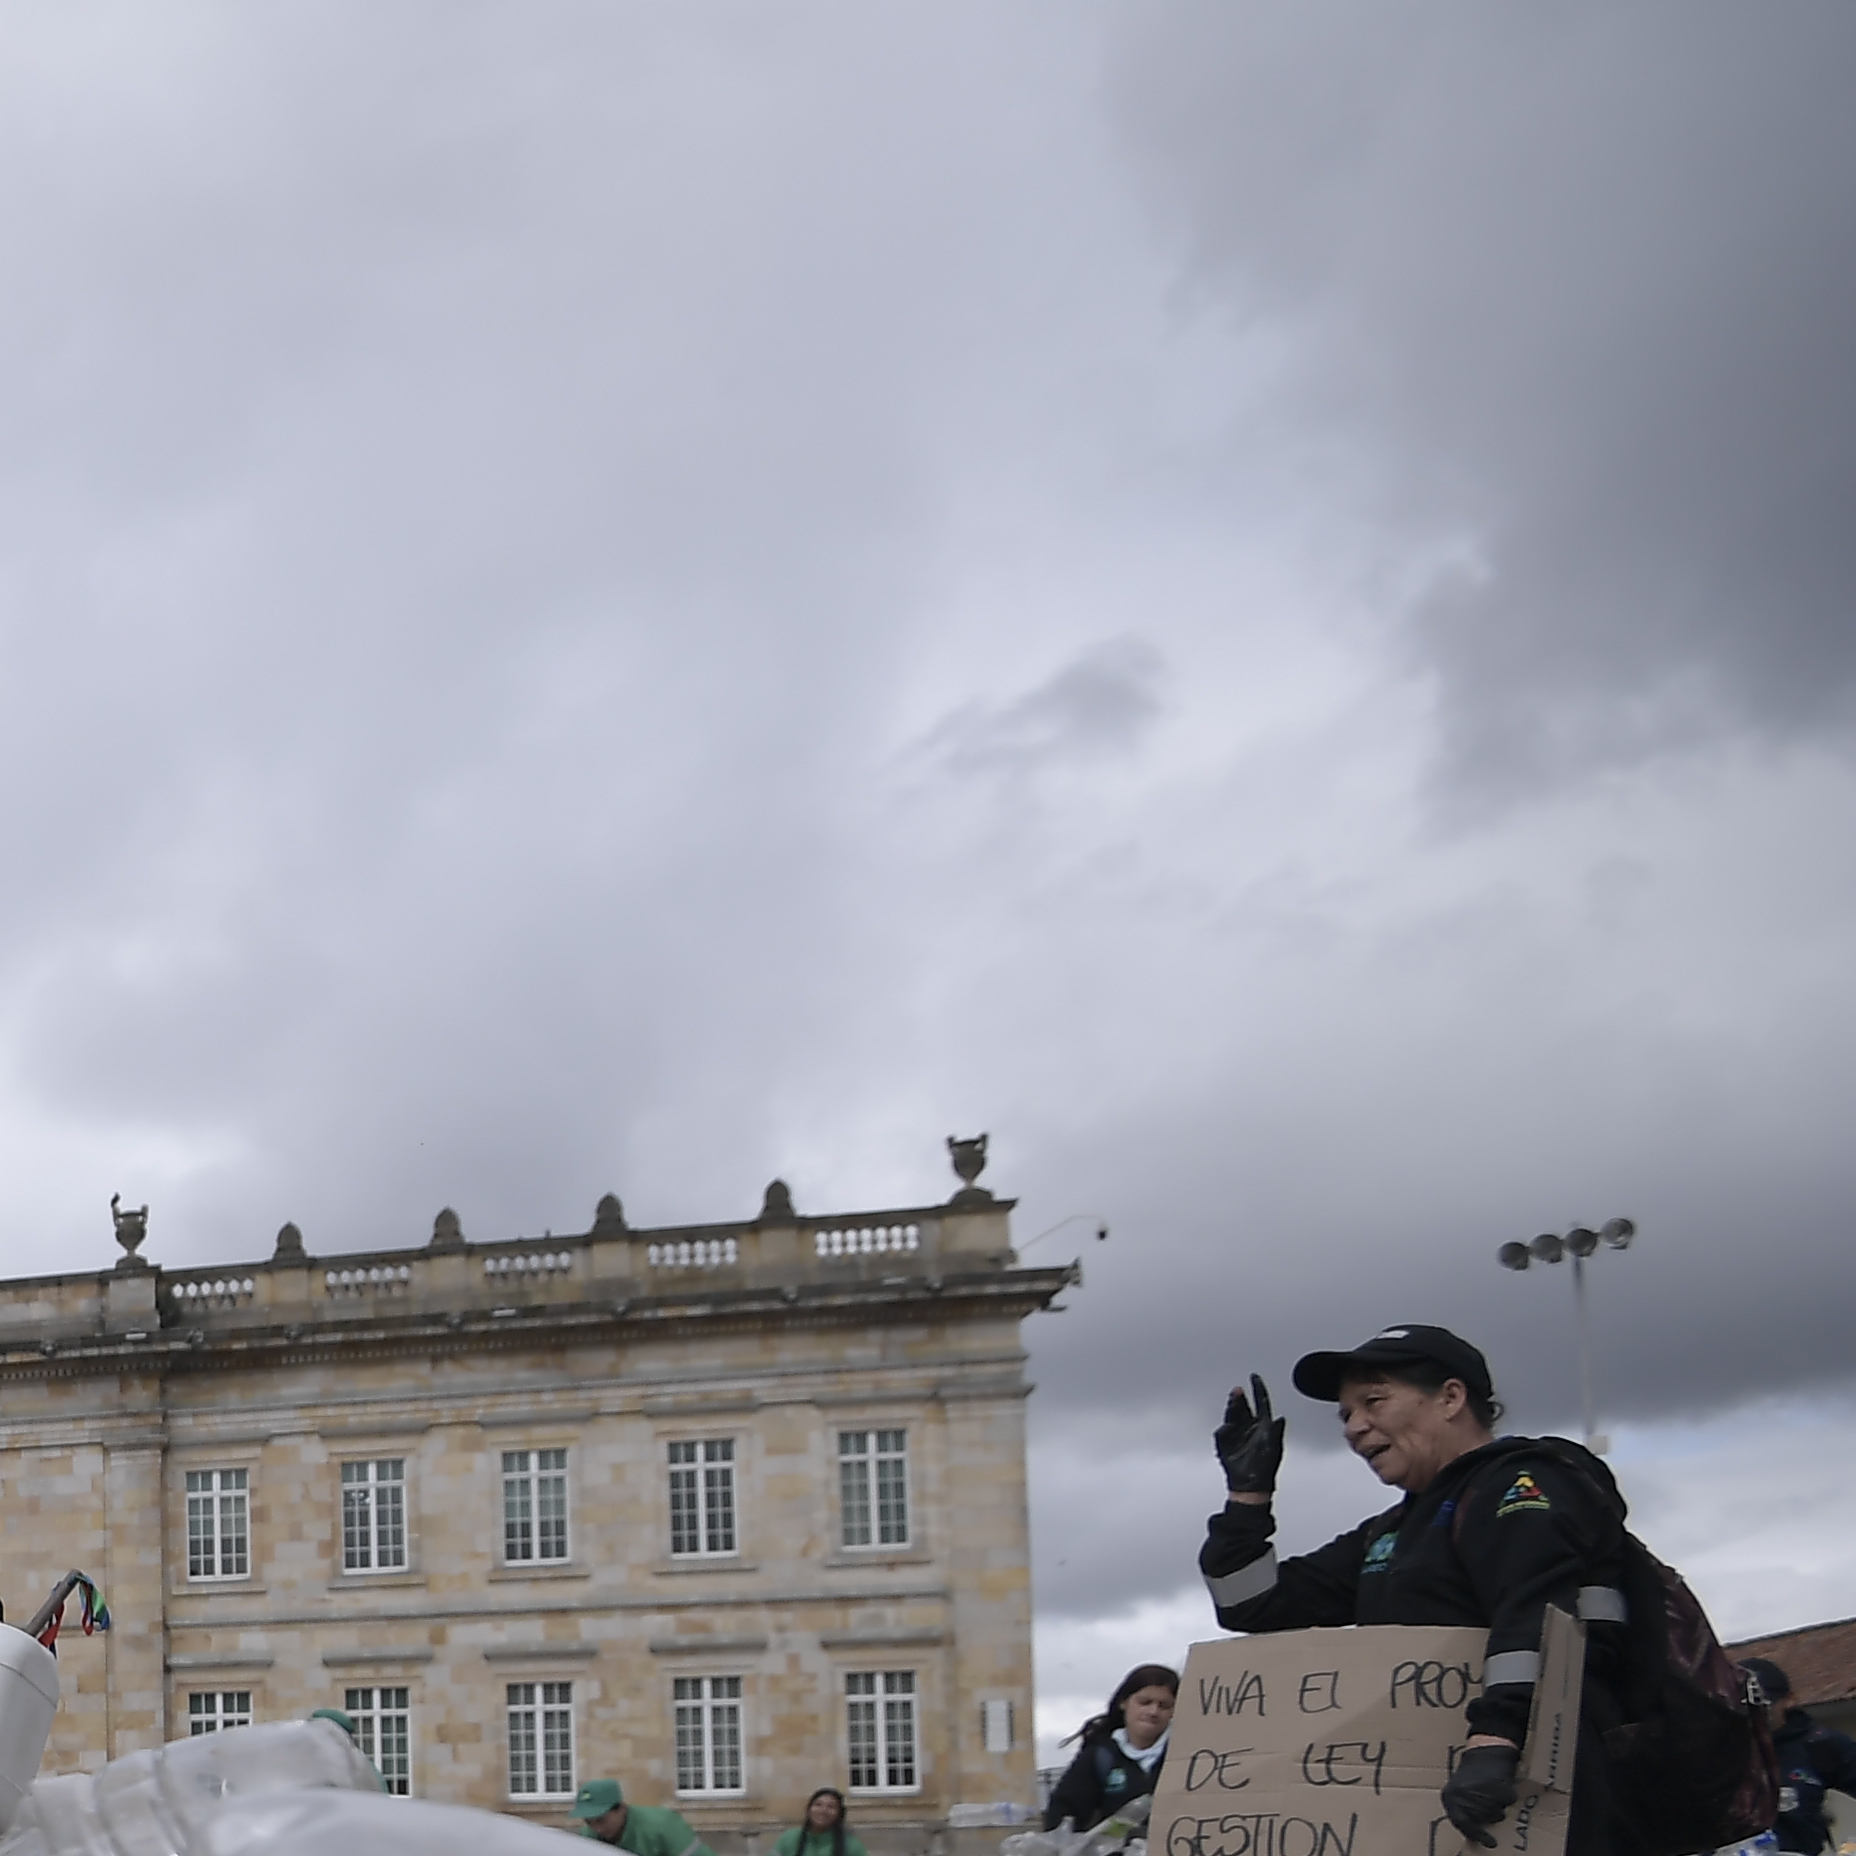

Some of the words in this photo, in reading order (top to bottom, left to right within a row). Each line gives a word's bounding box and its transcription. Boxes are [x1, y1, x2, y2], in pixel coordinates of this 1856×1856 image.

[1199, 1669, 1267, 1716] VIVA
[1187, 1747, 1255, 1792] DE
[1302, 1741, 1388, 1796] LEY
[1513, 1793, 1539, 1851] LADO
